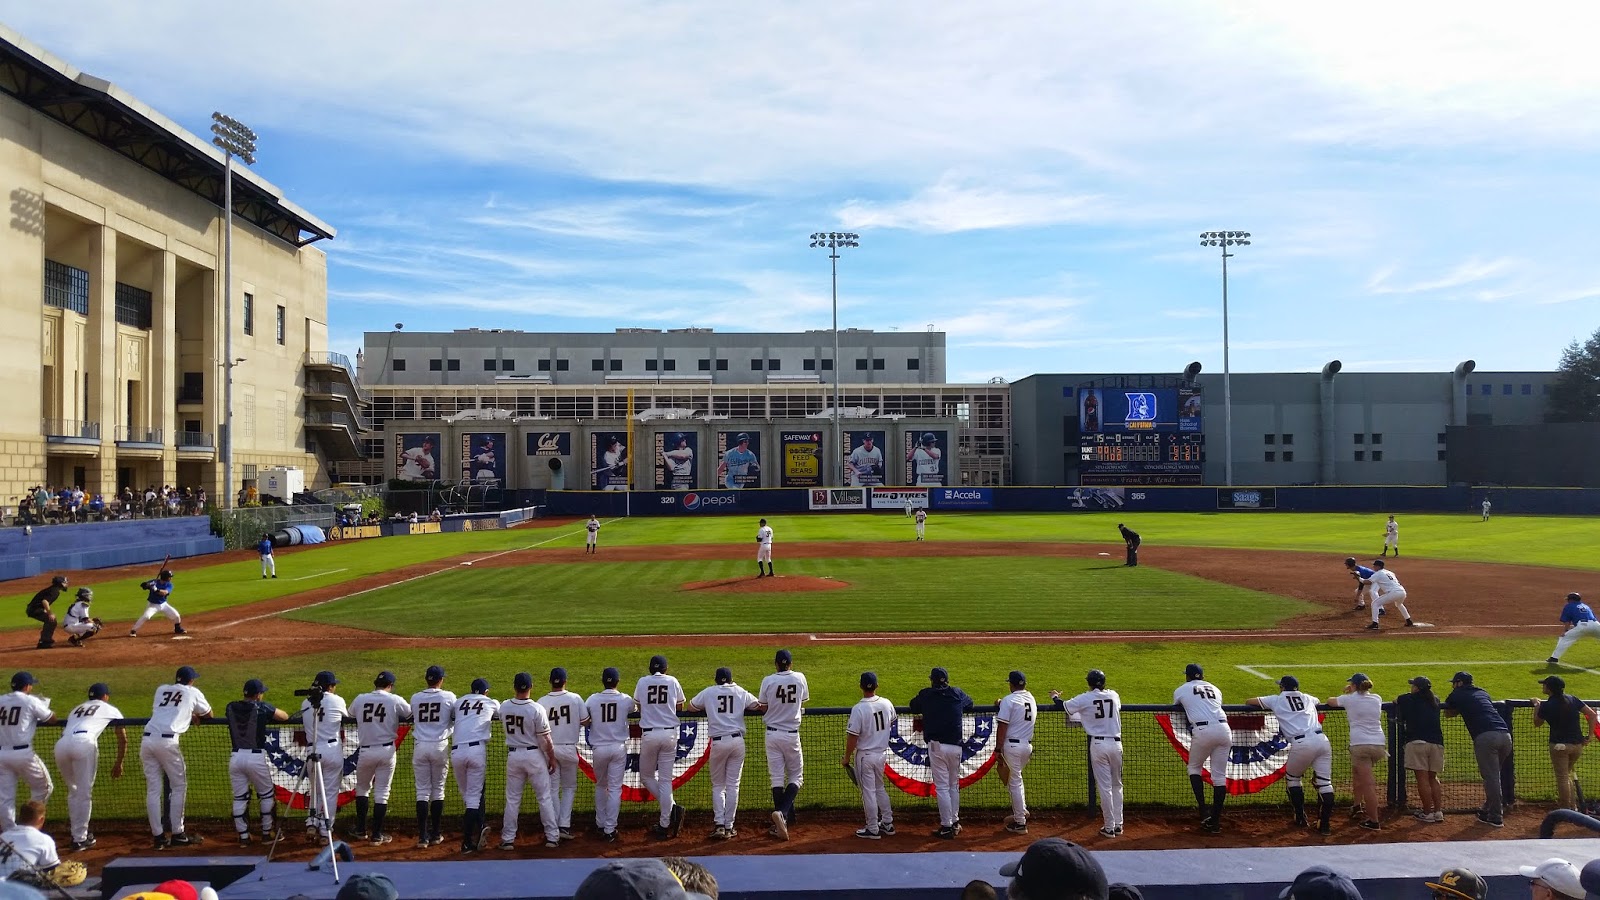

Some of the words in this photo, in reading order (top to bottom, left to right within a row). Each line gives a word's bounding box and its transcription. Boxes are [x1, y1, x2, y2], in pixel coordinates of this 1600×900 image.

[537, 432, 560, 451] Cal
[719, 433, 727, 457] LUKE
[784, 434, 811, 442] SAFEWAY
[1116, 434, 1122, 443] 0
[1154, 434, 1159, 443] 2
[463, 434, 471, 468] BOOKER
[1081, 453, 1091, 462] CAL
[656, 467, 665, 485] JON
[661, 496, 675, 504] 320
[702, 494, 736, 507] pepsi
[832, 490, 861, 505] Village
[953, 490, 981, 500] Accela
[1131, 492, 1146, 501] 365
[159, 691, 183, 708] 34
[647, 685, 668, 705] 26
[776, 684, 797, 703] 42
[73, 704, 101, 719] 48
[418, 702, 441, 723] 22
[459, 700, 484, 717] 44
[717, 695, 734, 714] 31
[1024, 702, 1032, 722] 2
[1092, 698, 1114, 719] 37
[1285, 695, 1305, 712] 16
[0, 705, 22, 726] 40
[363, 703, 386, 723] 24
[549, 705, 571, 726] 49
[600, 703, 618, 723] 10
[873, 710, 885, 732] 11
[505, 714, 524, 735] 29
[1442, 871, 1461, 887] Cal
